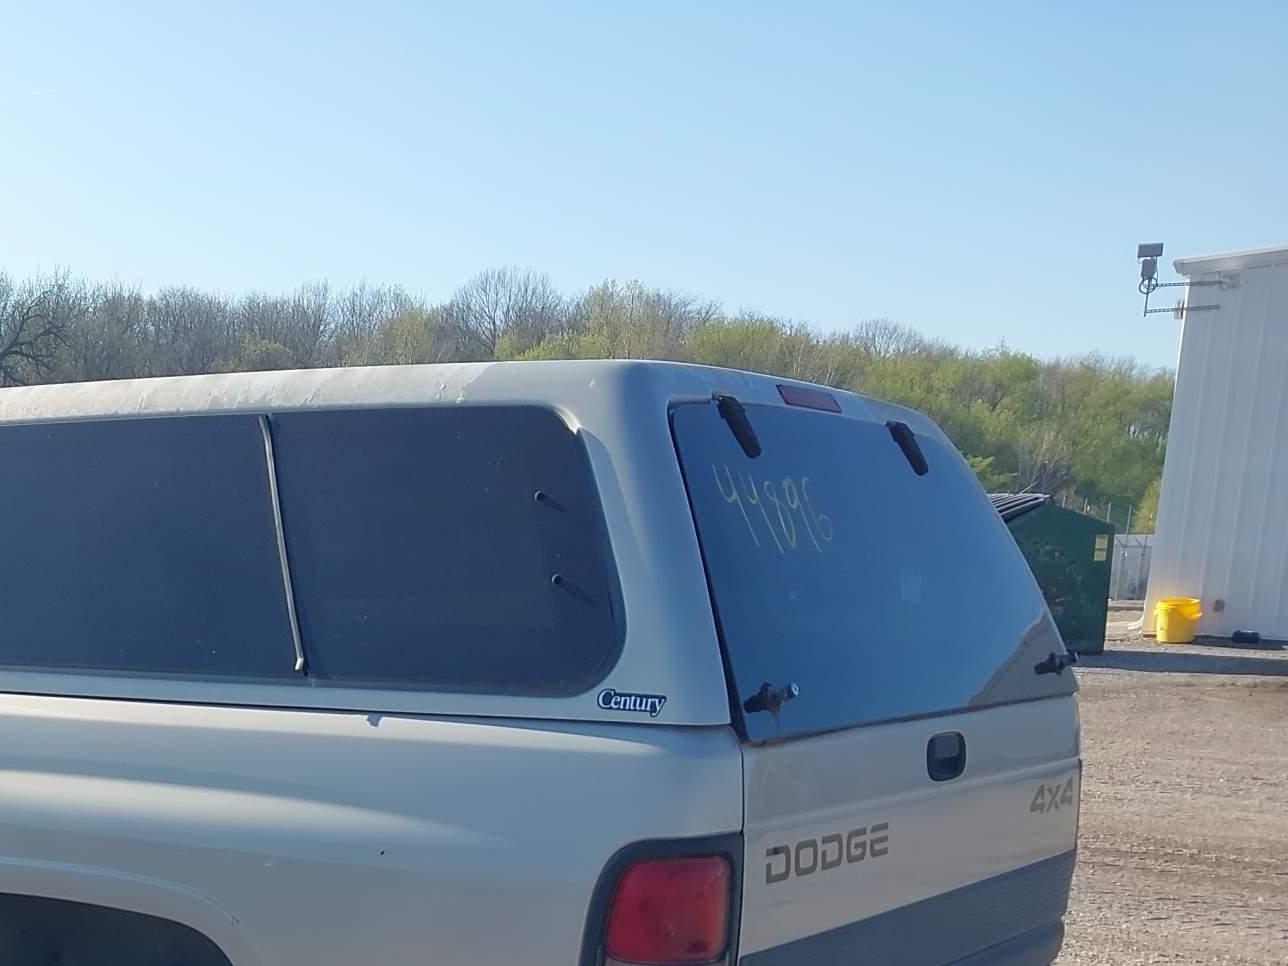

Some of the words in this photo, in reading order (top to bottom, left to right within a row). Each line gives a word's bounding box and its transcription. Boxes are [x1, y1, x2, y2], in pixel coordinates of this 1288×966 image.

[712, 464, 833, 554] 44896
[598, 689, 666, 717] Century
[766, 822, 888, 885] DODGE
